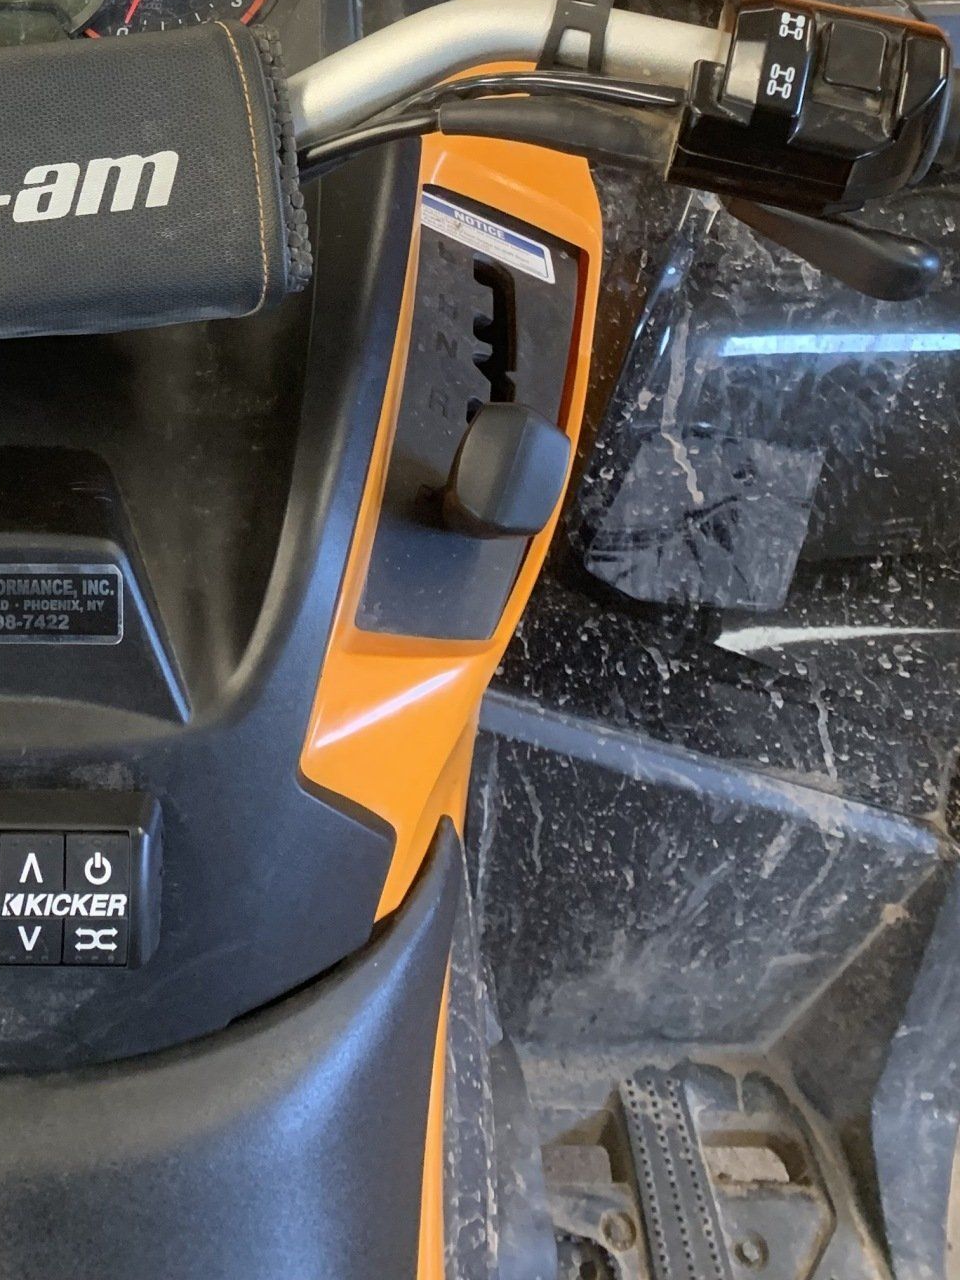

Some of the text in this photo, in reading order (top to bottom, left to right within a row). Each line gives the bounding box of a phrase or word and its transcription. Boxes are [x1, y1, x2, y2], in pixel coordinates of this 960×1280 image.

[453, 210, 506, 241] NOTICE
[82, 579, 115, 596] INC.
[23, 599, 84, 614] PHOENIX,
[87, 599, 106, 612] NY
[23, 893, 128, 917] KICKER
